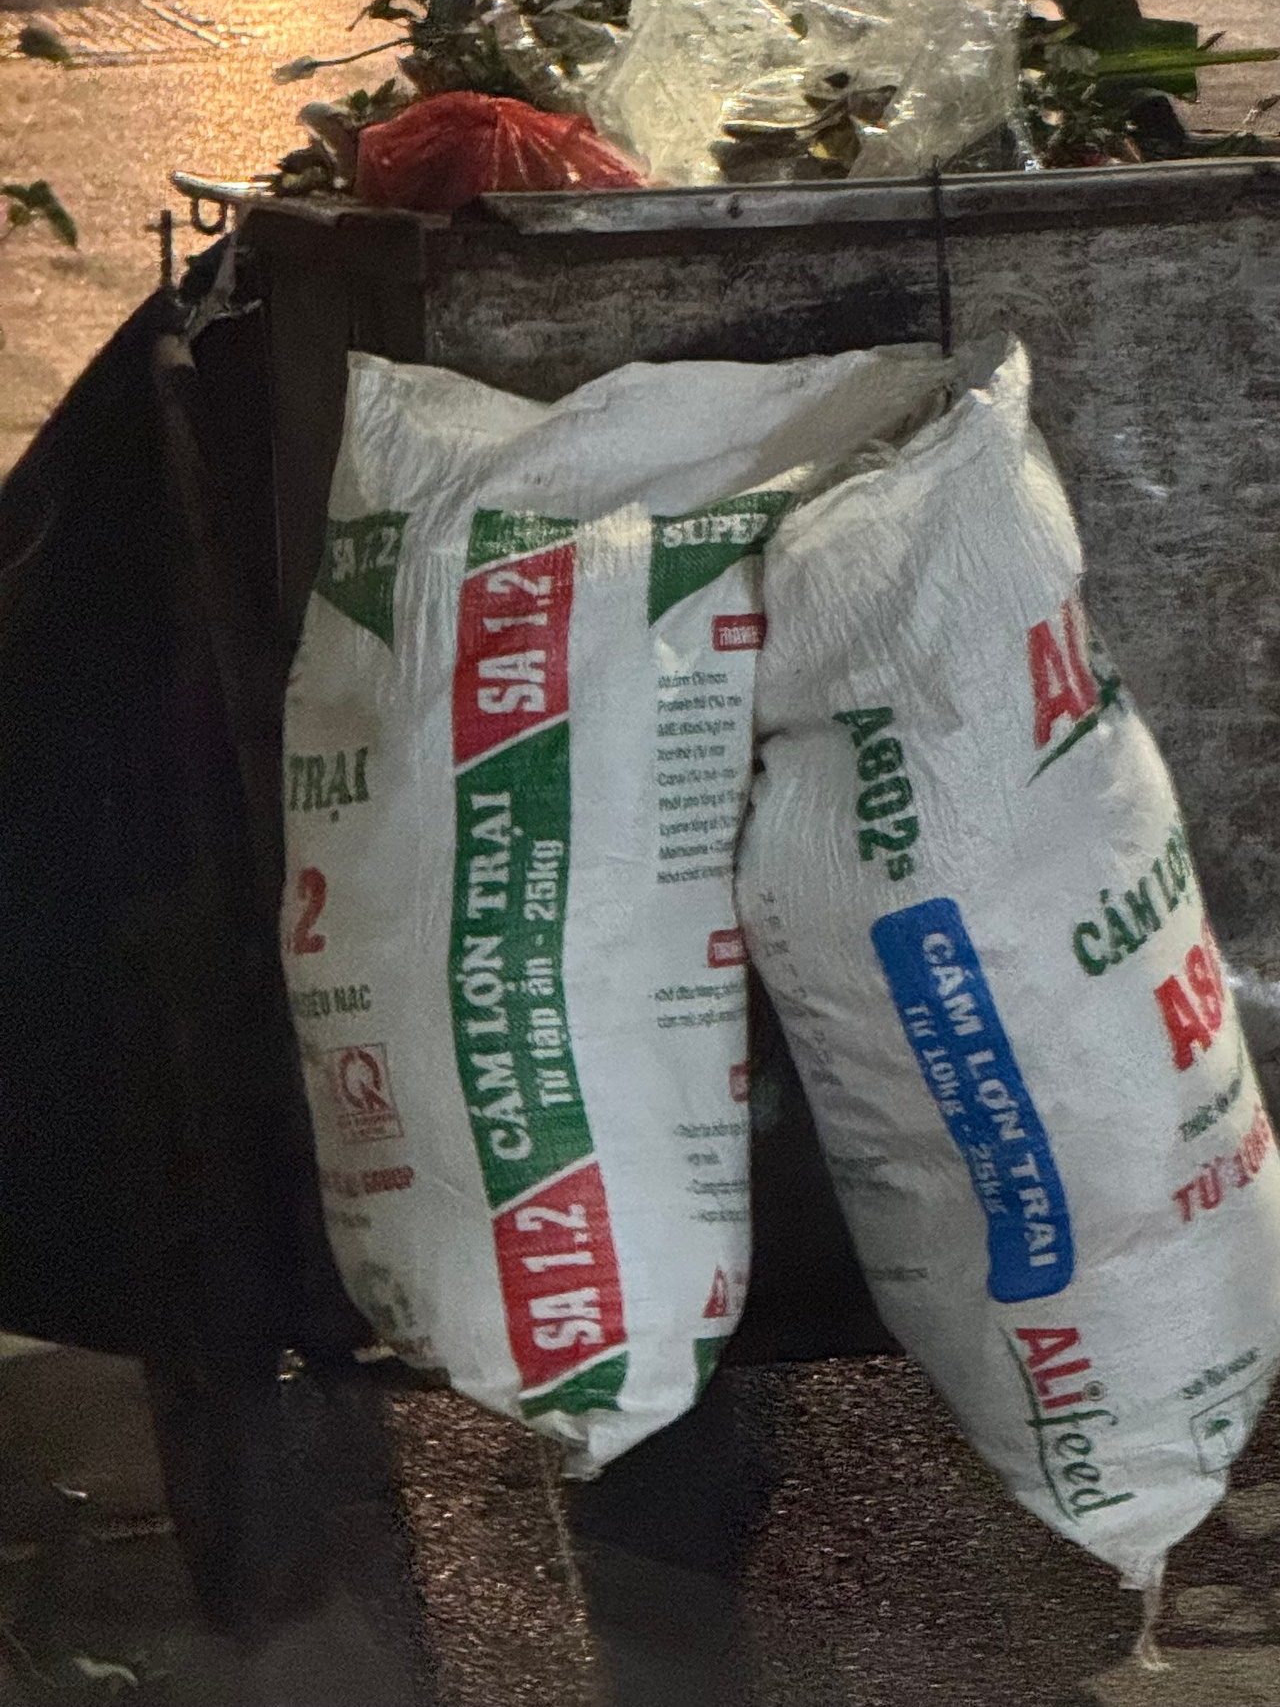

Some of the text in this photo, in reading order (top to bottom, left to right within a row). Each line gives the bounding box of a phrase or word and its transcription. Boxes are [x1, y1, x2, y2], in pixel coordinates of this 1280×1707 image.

[477, 570, 554, 715] SA 1.2
[523, 839, 565, 922] 25kg
[456, 792, 535, 1161] CÁM LỢN TRẠI
[922, 932, 985, 1037] CÁM
[515, 1203, 607, 1352] SA 1.2
